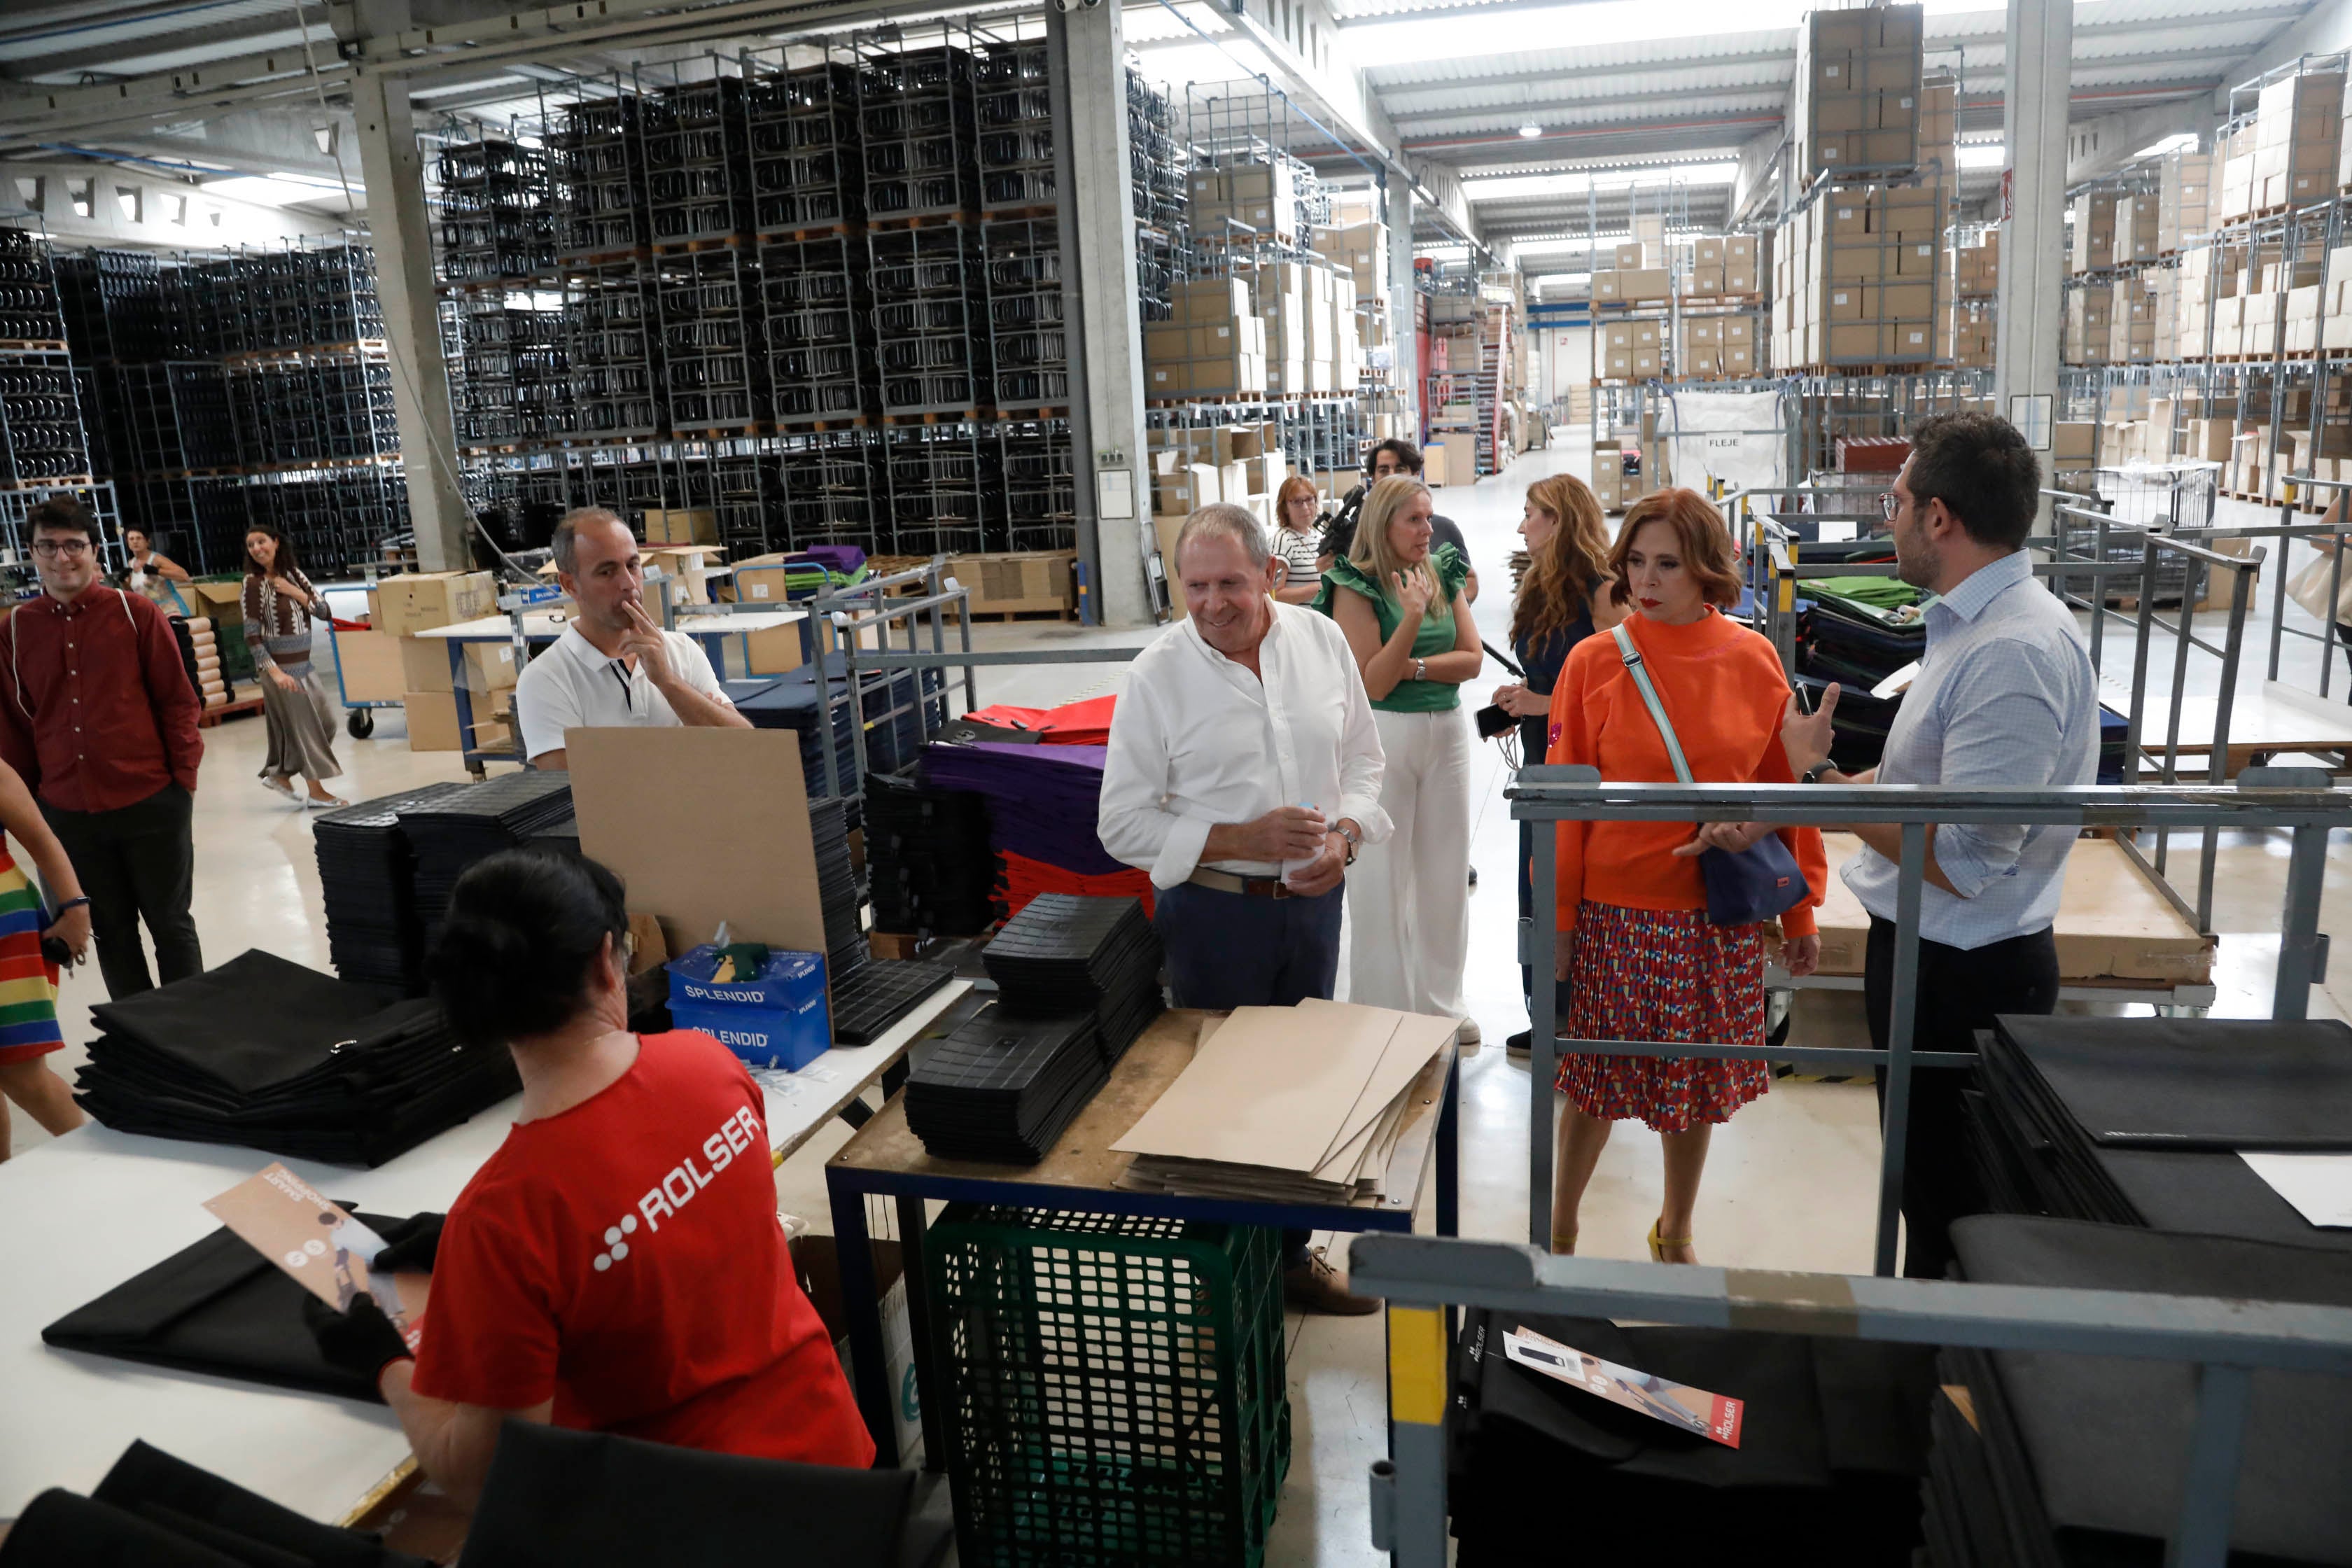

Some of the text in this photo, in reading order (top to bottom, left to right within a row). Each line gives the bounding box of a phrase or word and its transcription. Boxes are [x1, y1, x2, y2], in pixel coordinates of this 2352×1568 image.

[685, 985, 764, 1002] SPLENDID
[638, 1105, 761, 1233] ROLSER
[263, 1172, 303, 1202] SMART
[1475, 1324, 1485, 1358] ROLSER
[1723, 1401, 1736, 1435] ROLSER
